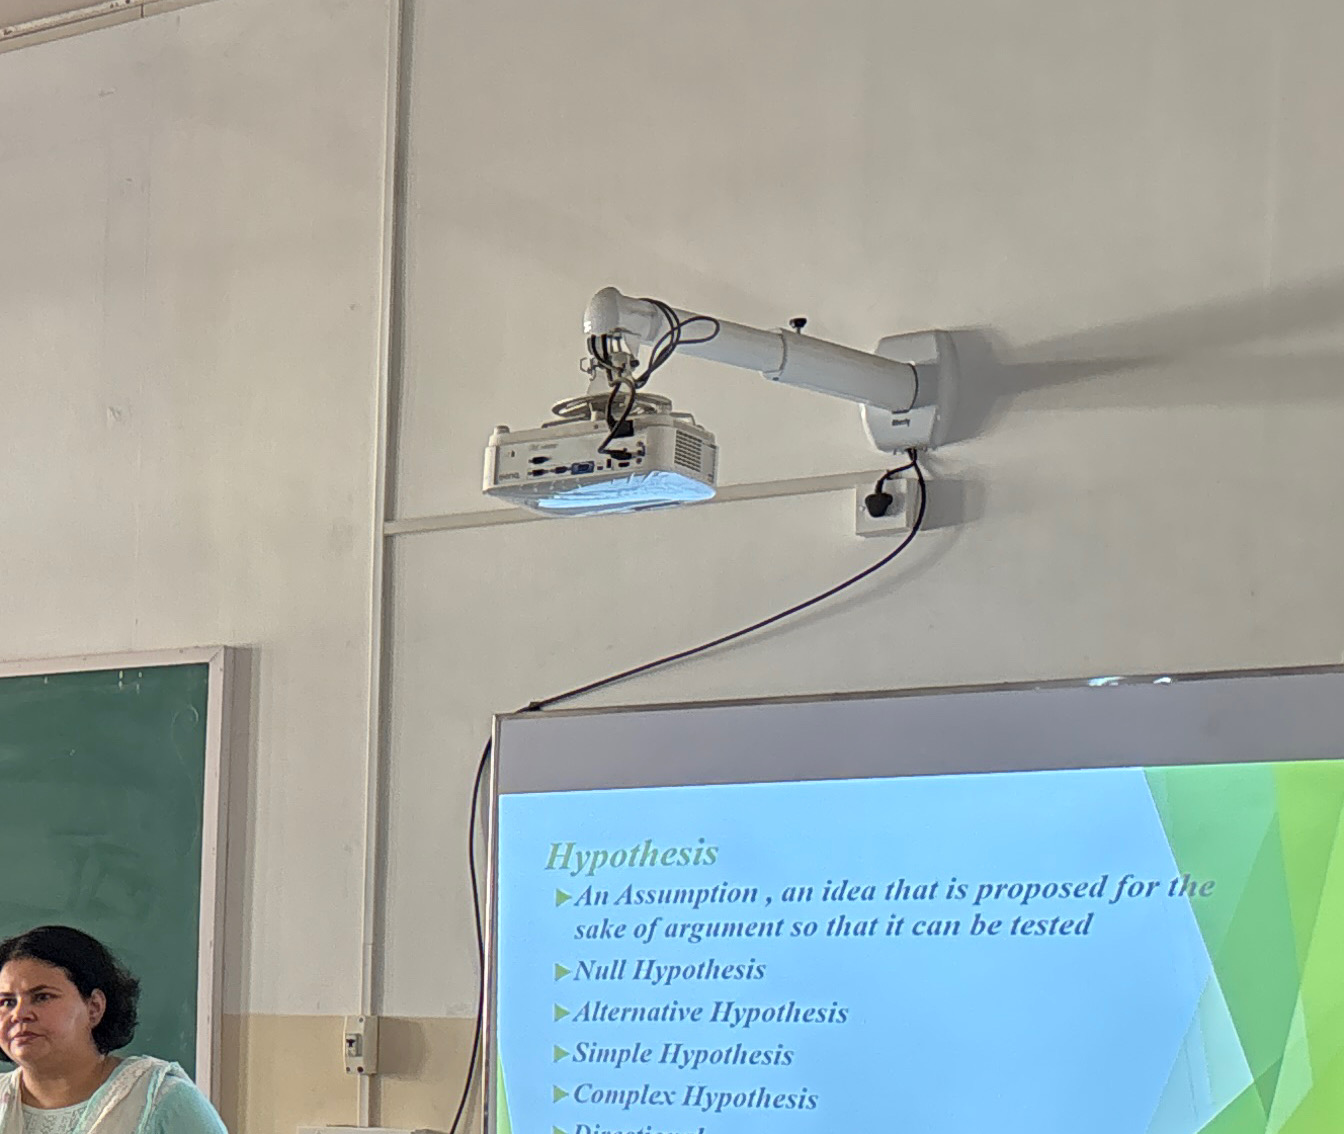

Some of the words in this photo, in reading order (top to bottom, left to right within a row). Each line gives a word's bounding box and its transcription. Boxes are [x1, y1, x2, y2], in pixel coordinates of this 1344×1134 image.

[544, 837, 720, 877] Hypothesis
[574, 884, 609, 908] An
[613, 881, 759, 910] Assumption
[780, 885, 814, 904] an
[821, 879, 877, 903] idea
[884, 877, 939, 901] that
[945, 877, 969, 900] is
[973, 874, 1110, 906] proposed
[1108, 873, 1161, 905] for
[1168, 872, 1217, 898] the
[574, 918, 627, 941] sake
[633, 917, 663, 945] of
[664, 918, 785, 945] argument
[789, 921, 818, 938] so
[826, 914, 879, 938] that
[884, 913, 905, 938] it
[911, 917, 961, 937] can
[969, 912, 1003, 937] be
[1010, 912, 1095, 937] tested
[573, 958, 628, 981] Null
[632, 957, 767, 986] Hypothesis
[572, 1000, 704, 1023] Alternative
[709, 1000, 850, 1029] Hypothesis
[572, 1041, 653, 1069] Simple
[658, 1042, 796, 1070] Hypothesis
[573, 1082, 677, 1111] Complex
[681, 1085, 820, 1113] Hypothesis
